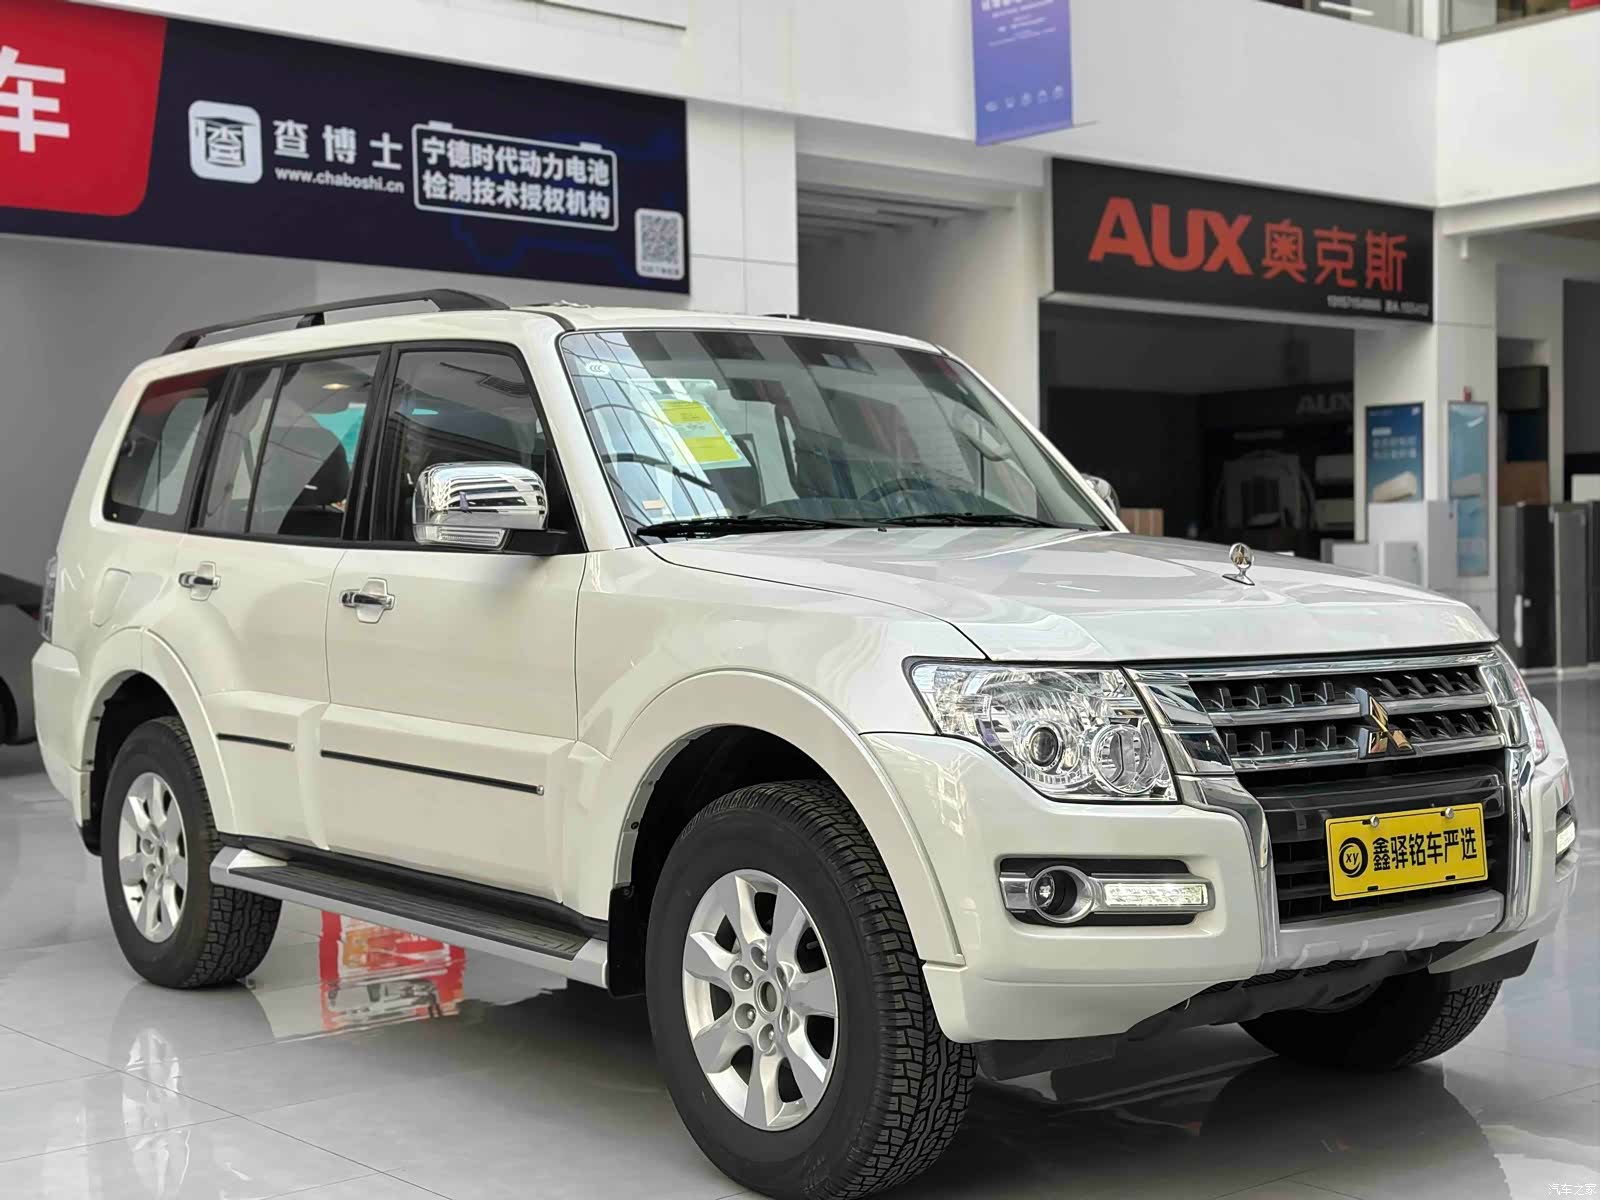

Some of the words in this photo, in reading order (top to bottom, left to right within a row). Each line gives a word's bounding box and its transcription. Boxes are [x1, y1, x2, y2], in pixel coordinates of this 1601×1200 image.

[273, 119, 404, 170] 查博士
[421, 136, 610, 187] 宁德时代动力电池
[274, 165, 405, 194] www.chaboshi.cn
[422, 170, 610, 220] 检测技术授权机构
[1088, 196, 1254, 276] AUX
[1261, 218, 1408, 292] 奥克斯
[1372, 827, 1478, 872] 鑫驿铭车严选
